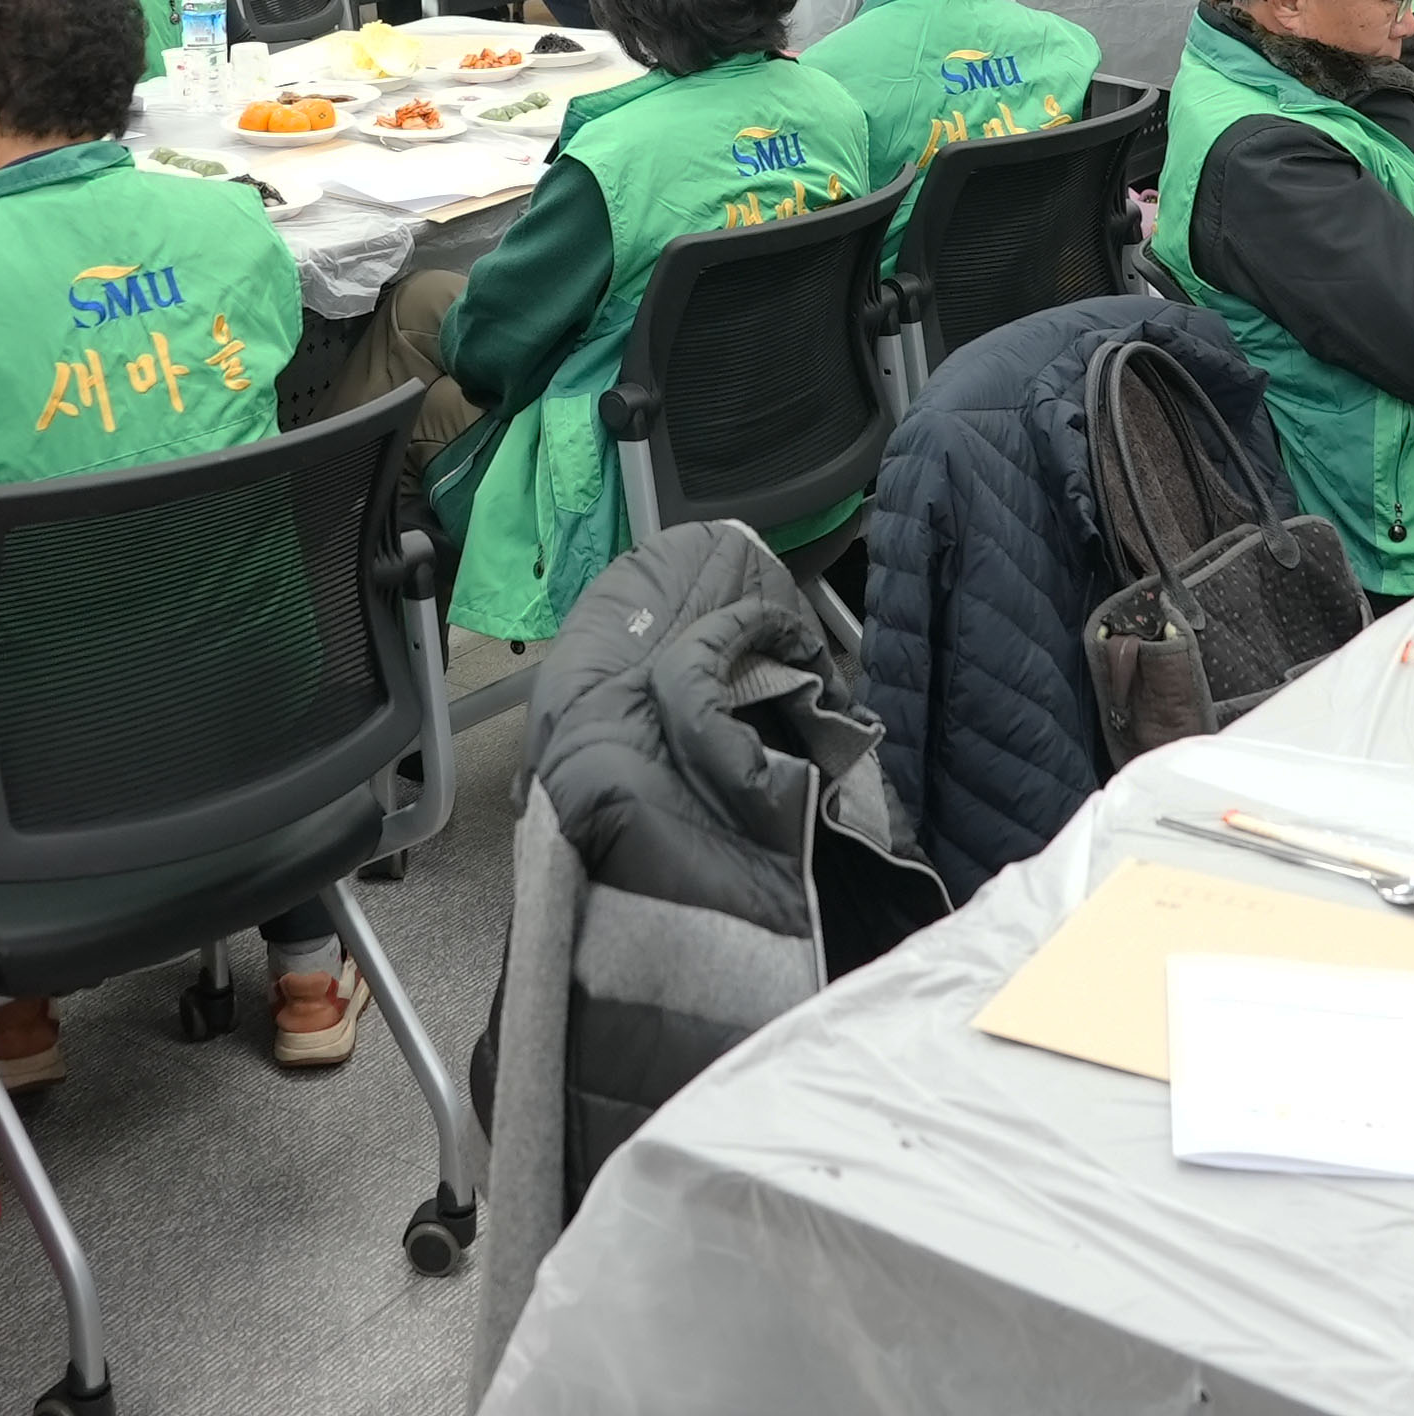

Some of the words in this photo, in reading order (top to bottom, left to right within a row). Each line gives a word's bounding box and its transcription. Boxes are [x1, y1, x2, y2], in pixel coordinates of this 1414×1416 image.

[941, 49, 1023, 95] SMU
[732, 127, 806, 177] SMU
[69, 264, 185, 328] SMU
[37, 314, 251, 432] 새마을
